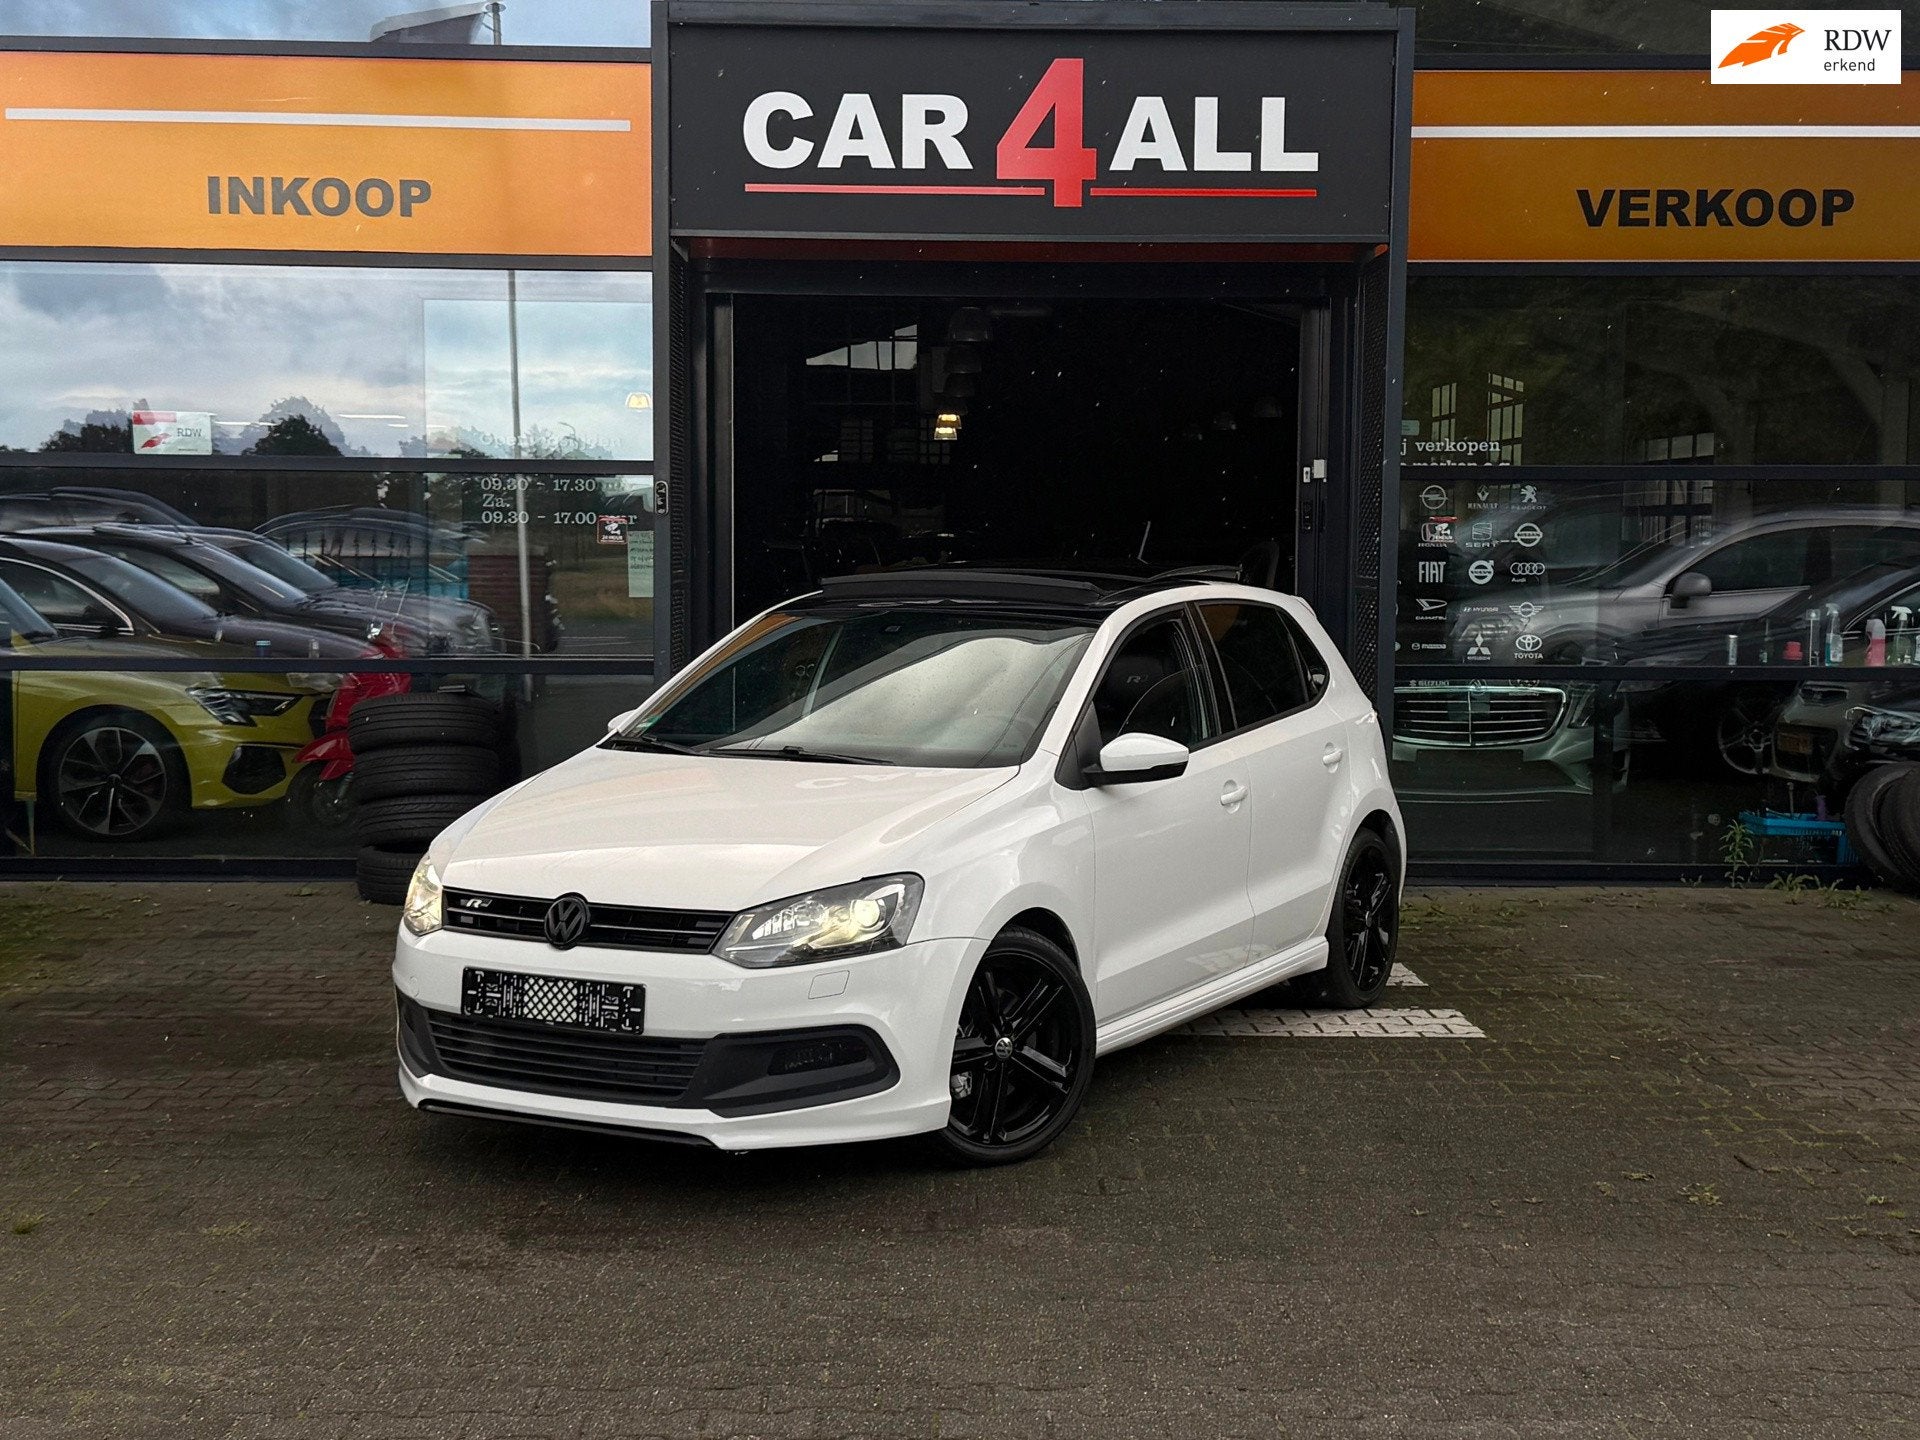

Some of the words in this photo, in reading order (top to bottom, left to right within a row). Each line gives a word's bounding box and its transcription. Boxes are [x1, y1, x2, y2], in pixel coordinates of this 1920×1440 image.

[743, 91, 974, 169] CAR
[996, 58, 1097, 207] 4
[1110, 96, 1319, 172] ALL
[207, 175, 432, 217] INKOOP
[1575, 188, 1855, 227] VERKOOP
[177, 428, 202, 437] RDW
[1415, 438, 1501, 456] verkopen
[480, 477, 529, 491] 09.30
[552, 478, 596, 491] 17.30
[482, 494, 511, 508] Za.
[481, 511, 530, 524] 09.30
[553, 511, 597, 525] 17.00
[1418, 561, 1447, 583] FIAT
[1514, 652, 1544, 660] TOYOTA
